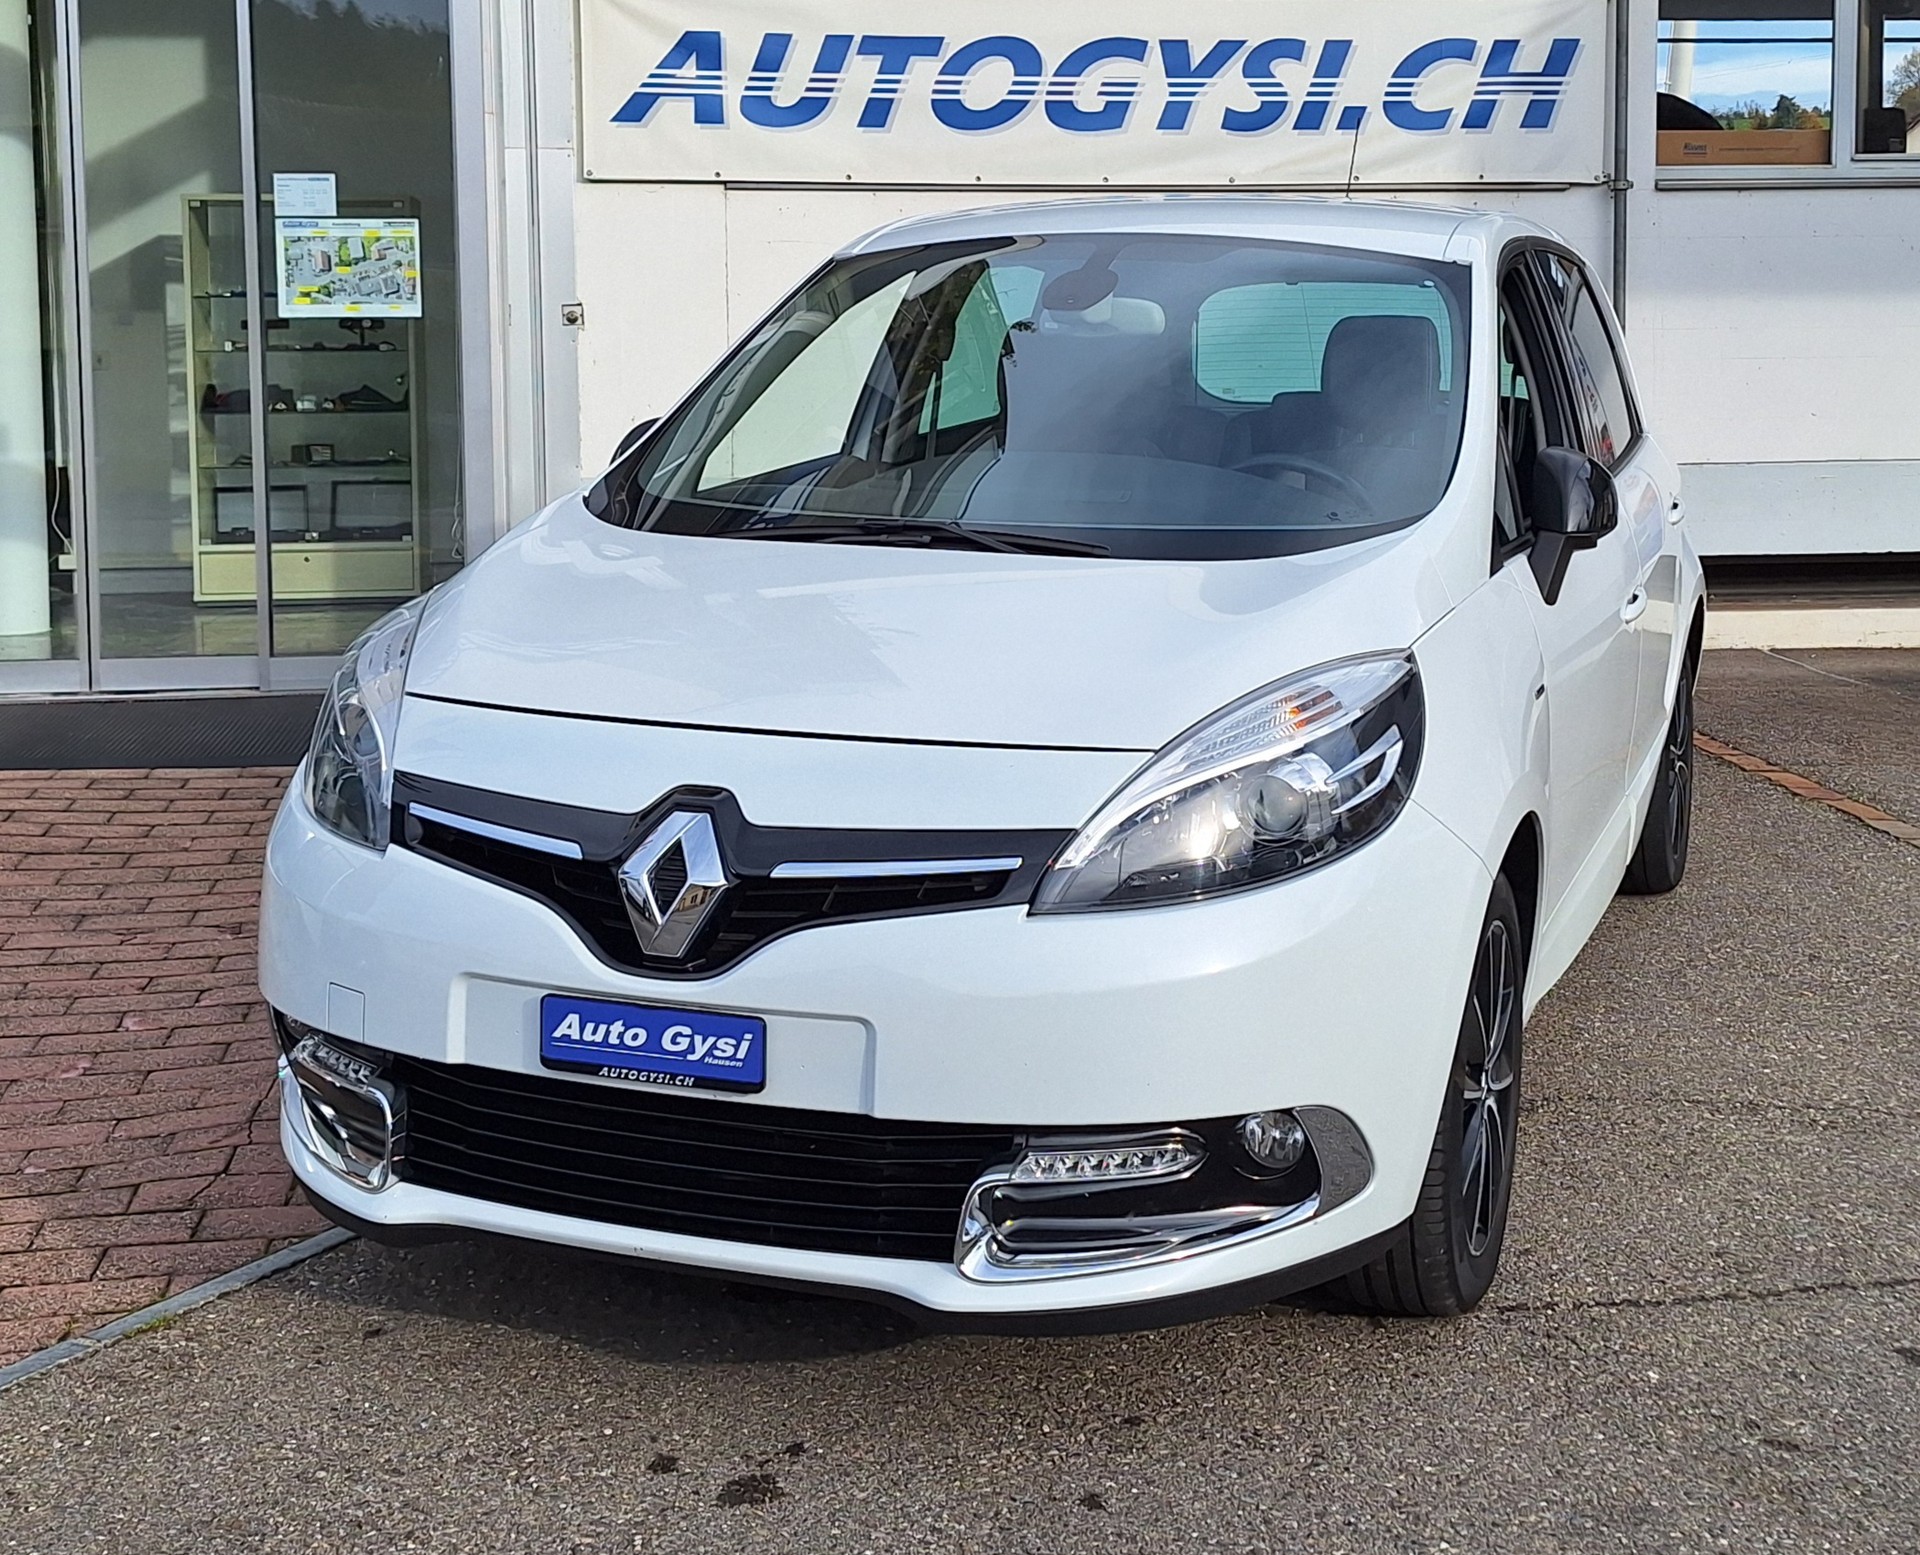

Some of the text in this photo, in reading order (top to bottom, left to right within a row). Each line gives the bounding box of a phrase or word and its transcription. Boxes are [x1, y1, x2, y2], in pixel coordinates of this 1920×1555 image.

[609, 29, 1582, 135] AUTOGYSI.CH
[551, 1012, 754, 1061] Auto Gysi
[598, 1066, 696, 1087] AUTOGYSI.CH
[703, 1055, 744, 1068] Hausen
